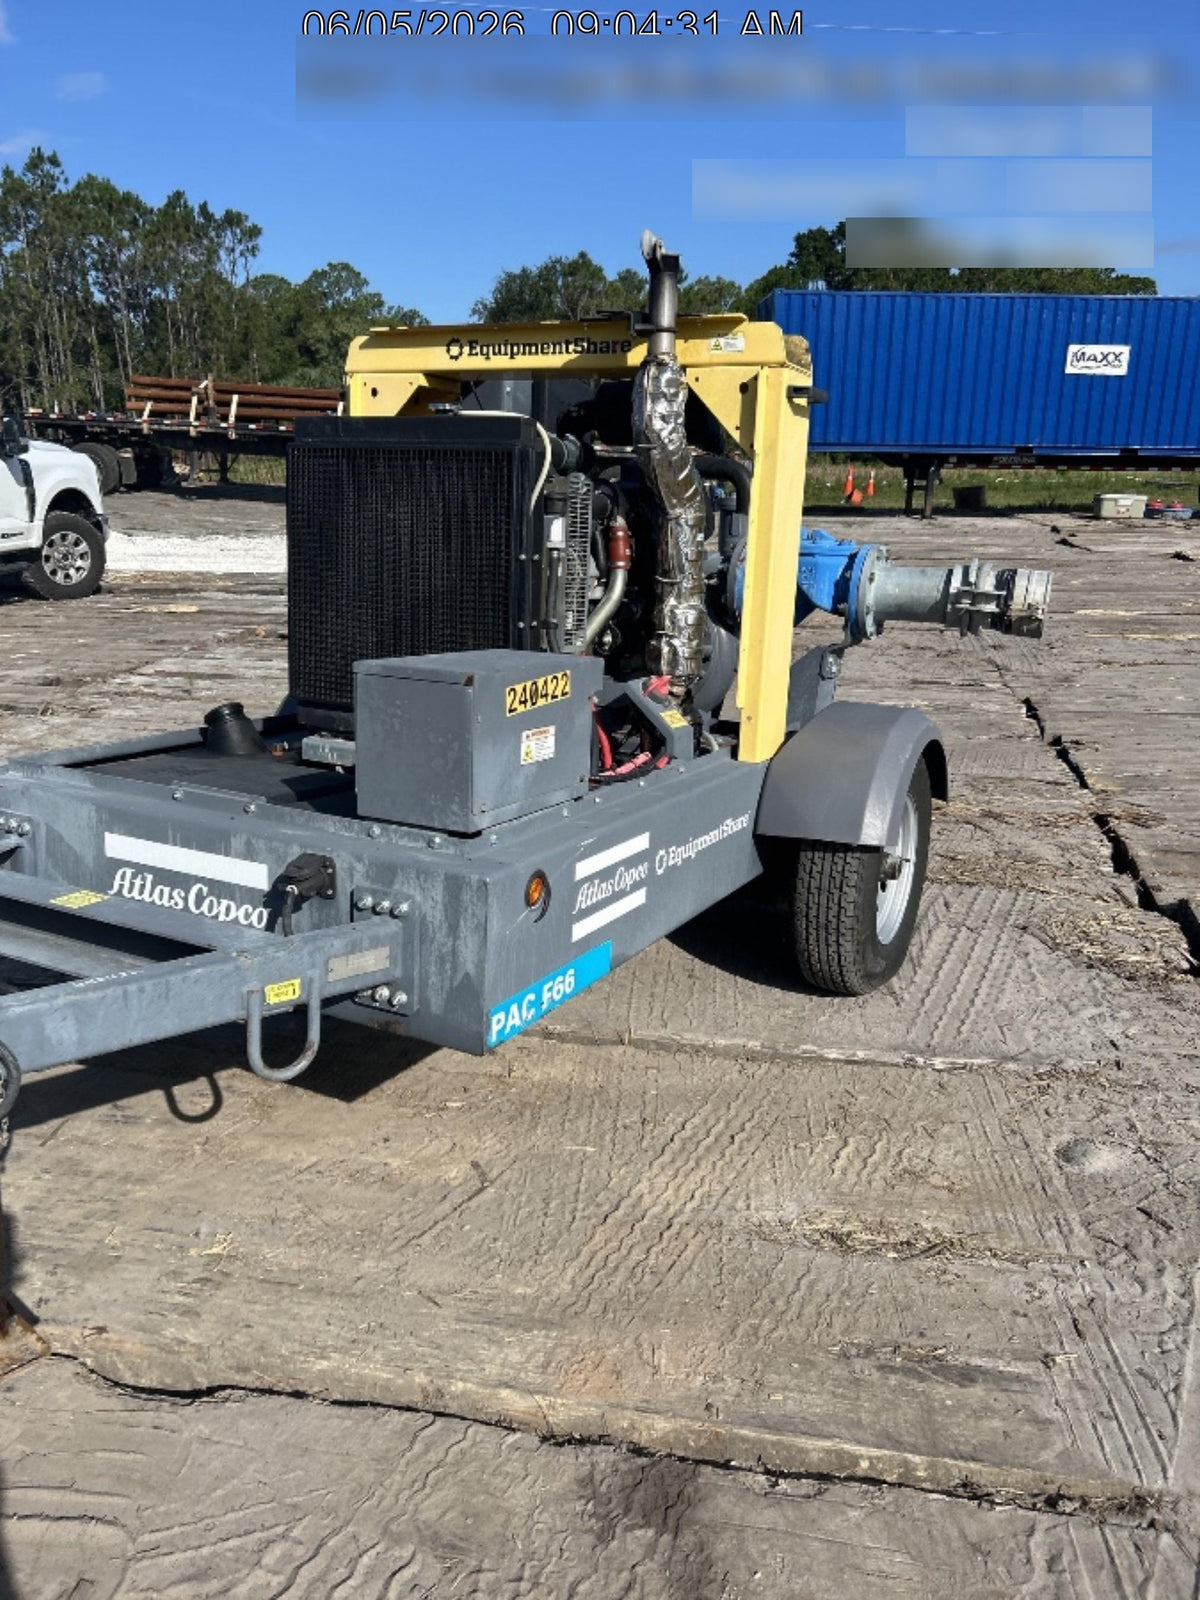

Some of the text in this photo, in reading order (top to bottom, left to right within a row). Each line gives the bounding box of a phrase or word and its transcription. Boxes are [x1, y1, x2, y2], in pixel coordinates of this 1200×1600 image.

[467, 337, 632, 360] EquipmentShare
[1070, 347, 1124, 368] MAXX
[508, 673, 569, 713] 240422
[668, 812, 751, 867] EquipmentShare
[107, 867, 186, 909] Atlas
[188, 883, 269, 929] Copco
[572, 862, 650, 914] Atlas Copco
[491, 968, 575, 1042] PAC F66
